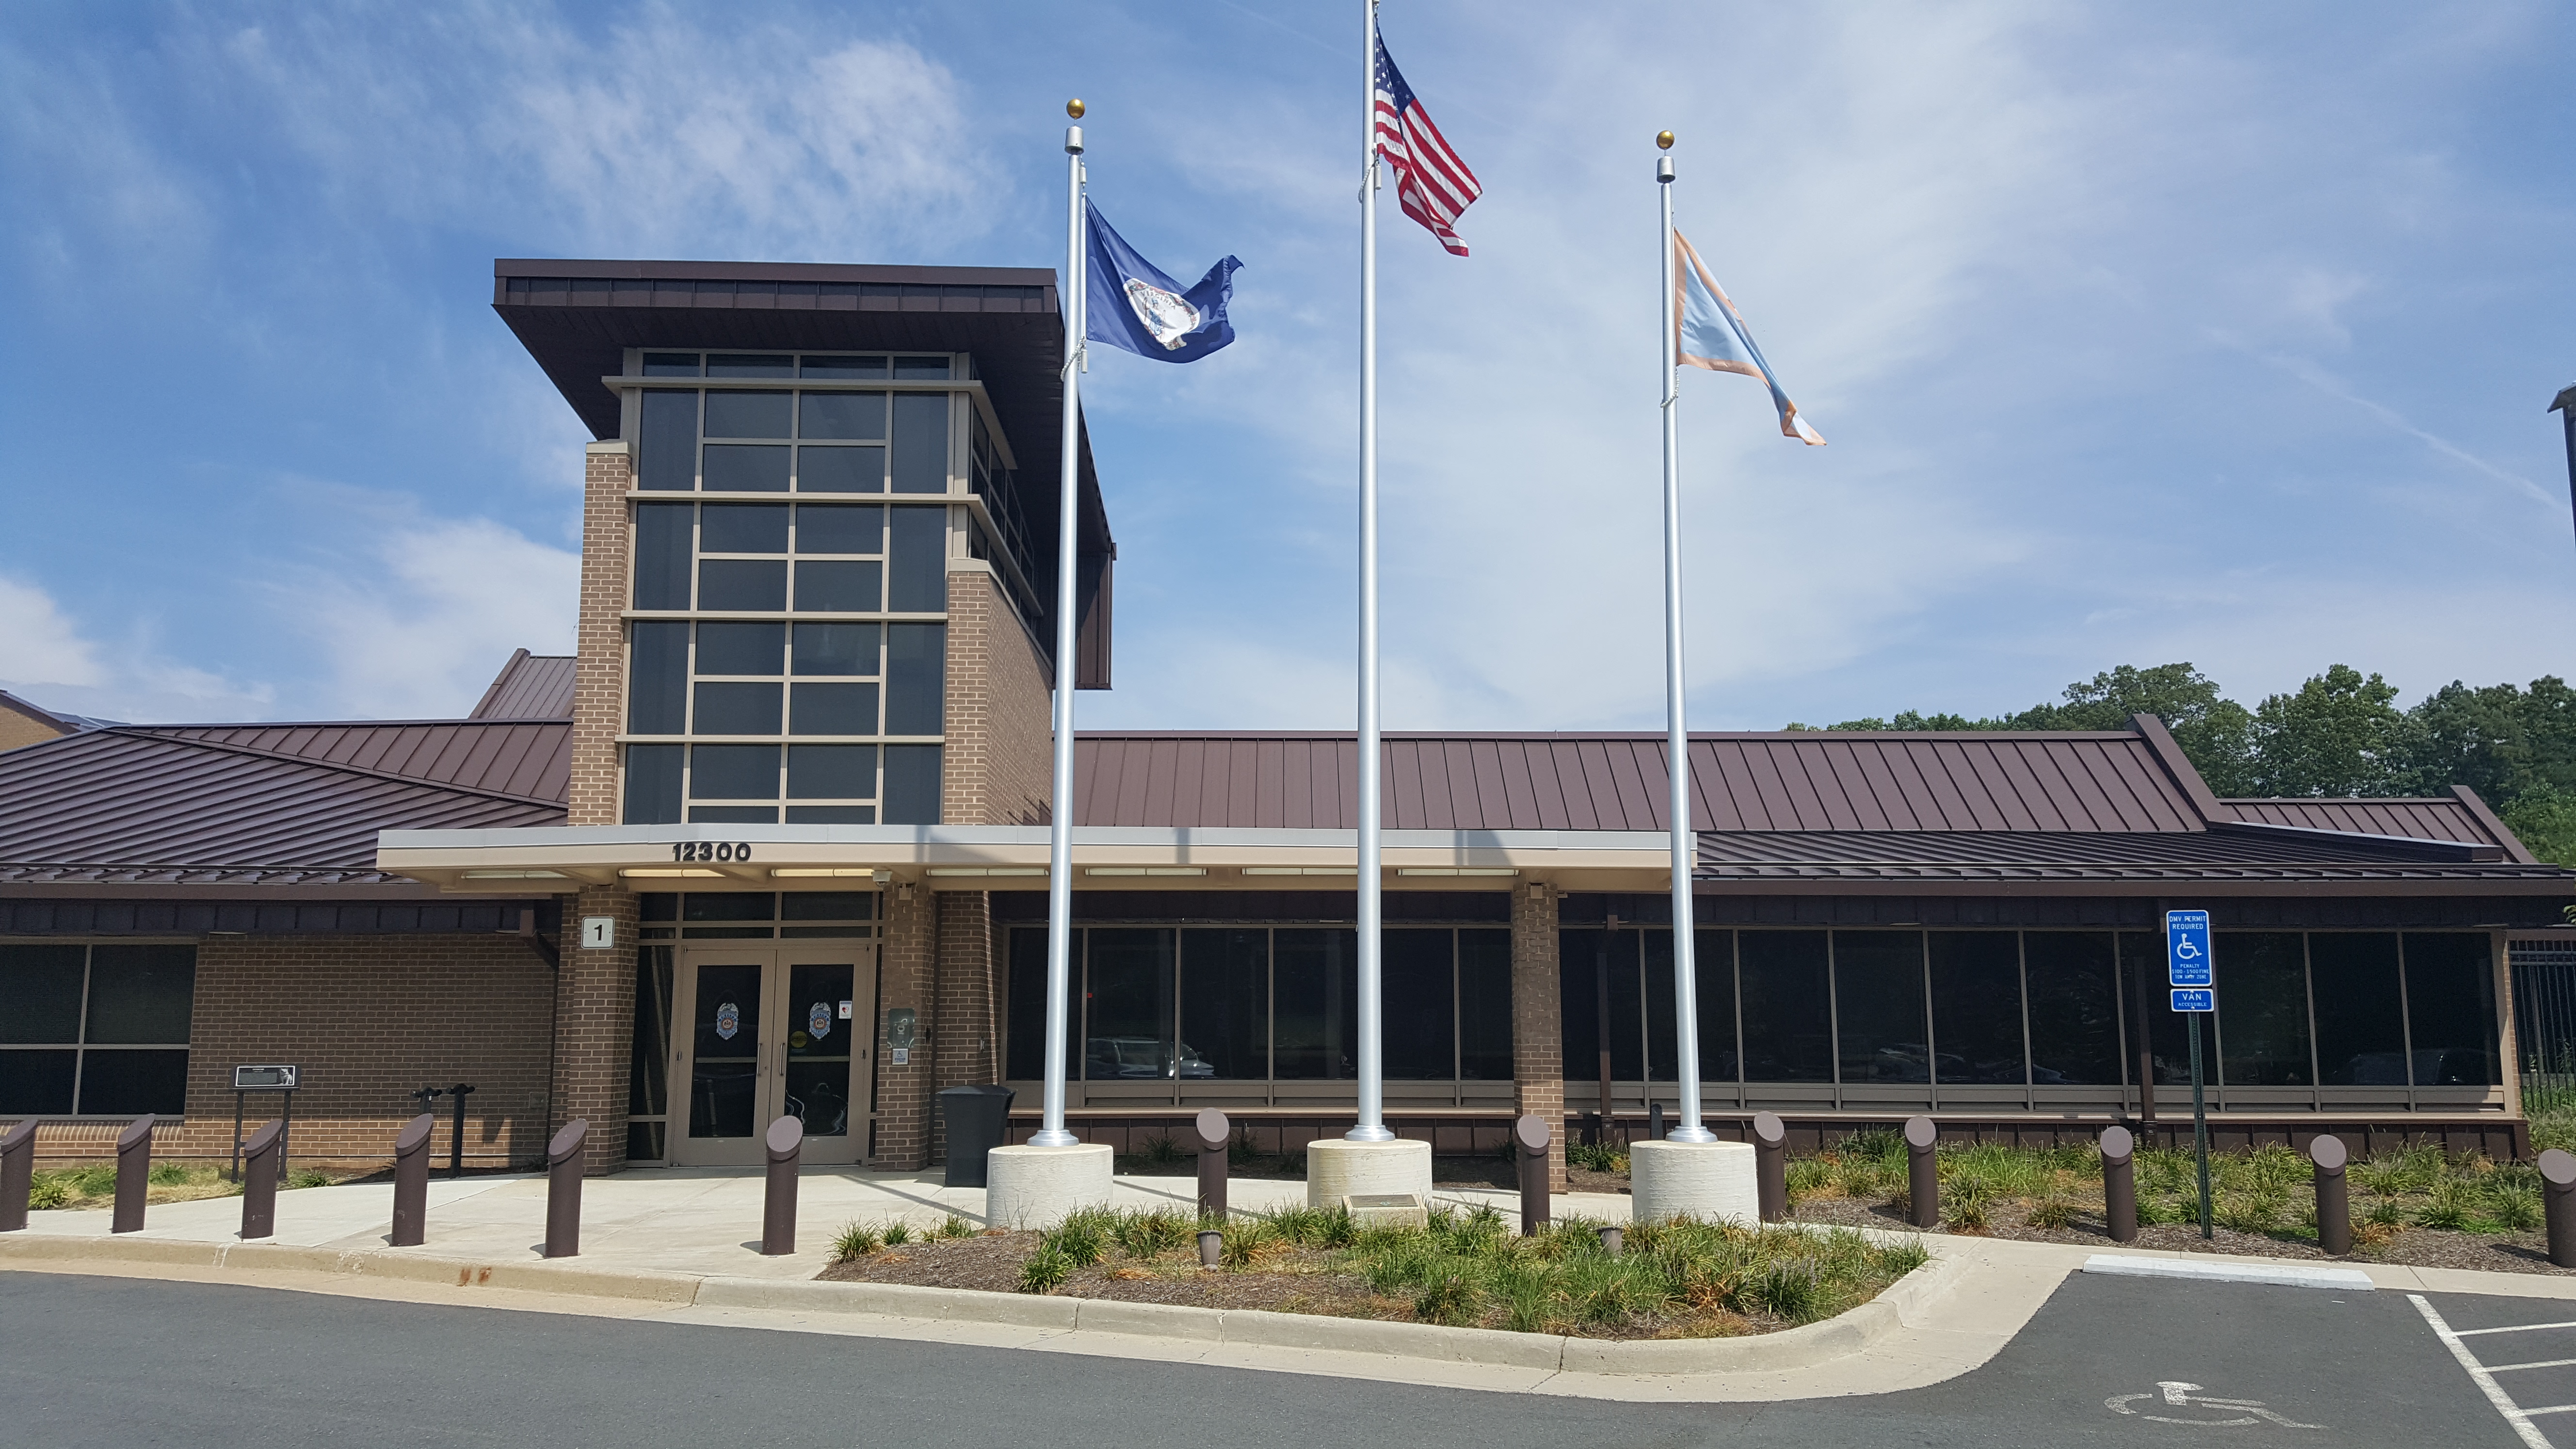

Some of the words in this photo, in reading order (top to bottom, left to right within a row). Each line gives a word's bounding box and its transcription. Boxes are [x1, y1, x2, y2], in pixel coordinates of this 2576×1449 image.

[1141, 291, 1175, 309] VIRGINIA
[673, 842, 751, 861] 12300
[594, 924, 602, 941] 1
